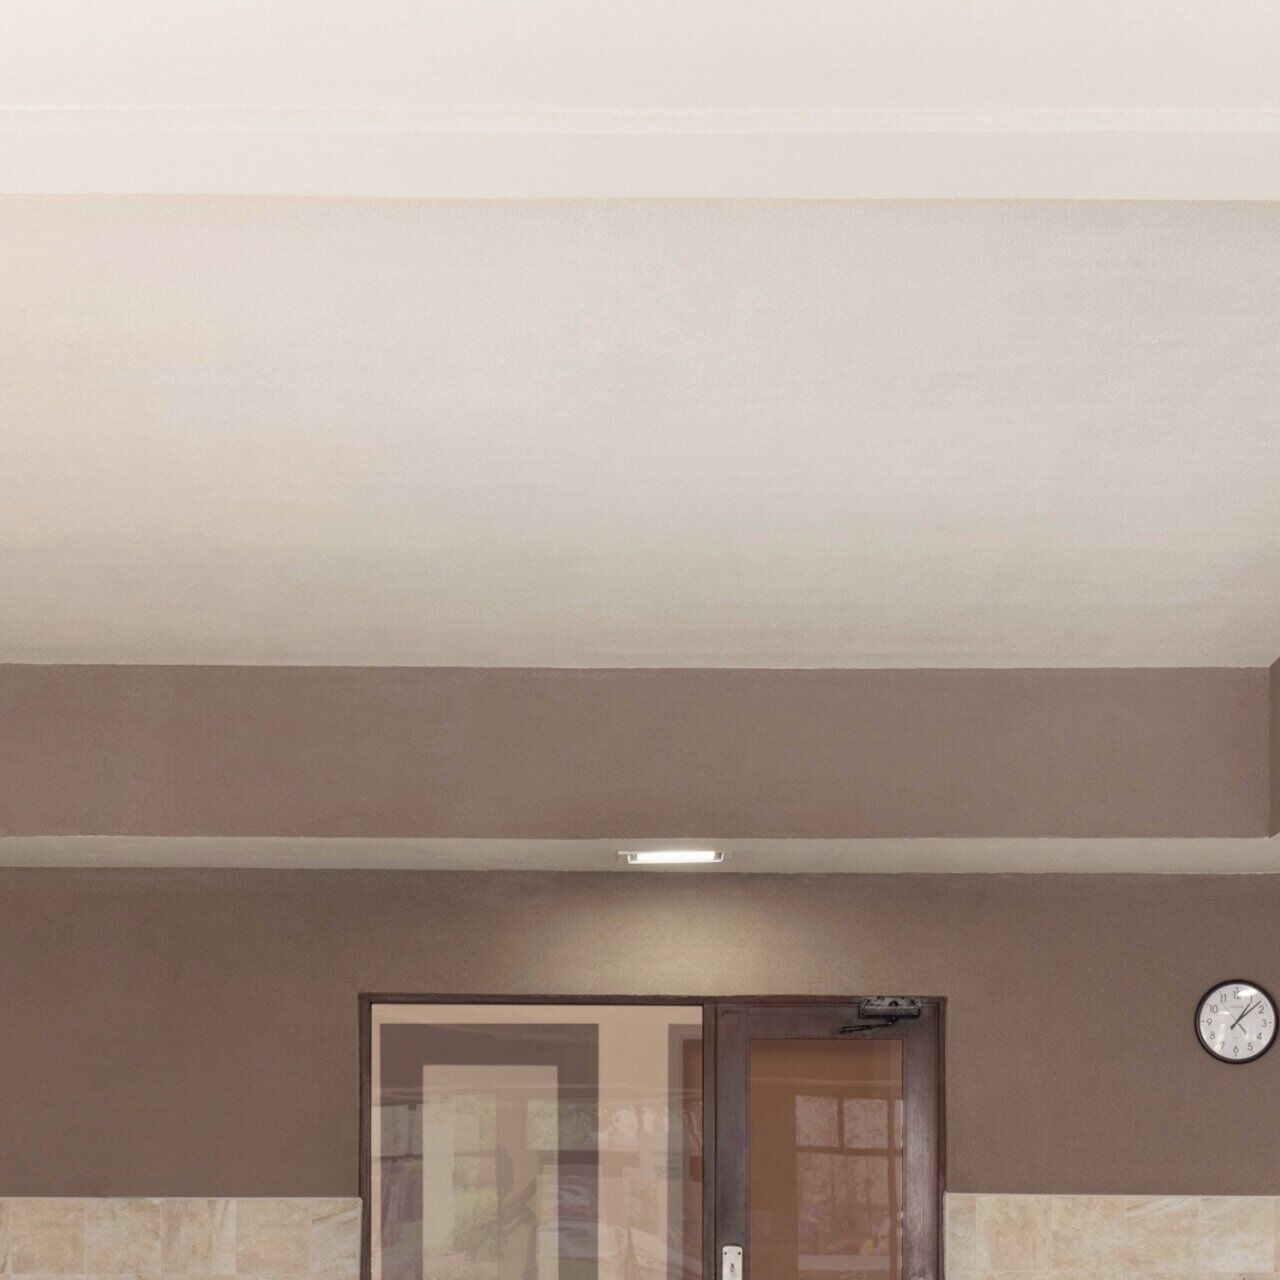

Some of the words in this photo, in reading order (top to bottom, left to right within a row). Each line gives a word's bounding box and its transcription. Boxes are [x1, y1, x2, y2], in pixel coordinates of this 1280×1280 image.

[1221, 994, 1227, 1003] 11
[1250, 995, 1252, 1003] 1
[1210, 1005, 1218, 1013] 10
[1258, 1006, 1264, 1014] 2
[1206, 1018, 1212, 1026] 9
[1262, 1019, 1267, 1027] 3
[1210, 1031, 1215, 1040] 8
[1257, 1032, 1262, 1040] 4
[1233, 1045, 1239, 1053] 6
[1248, 1043, 1253, 1051] 5
